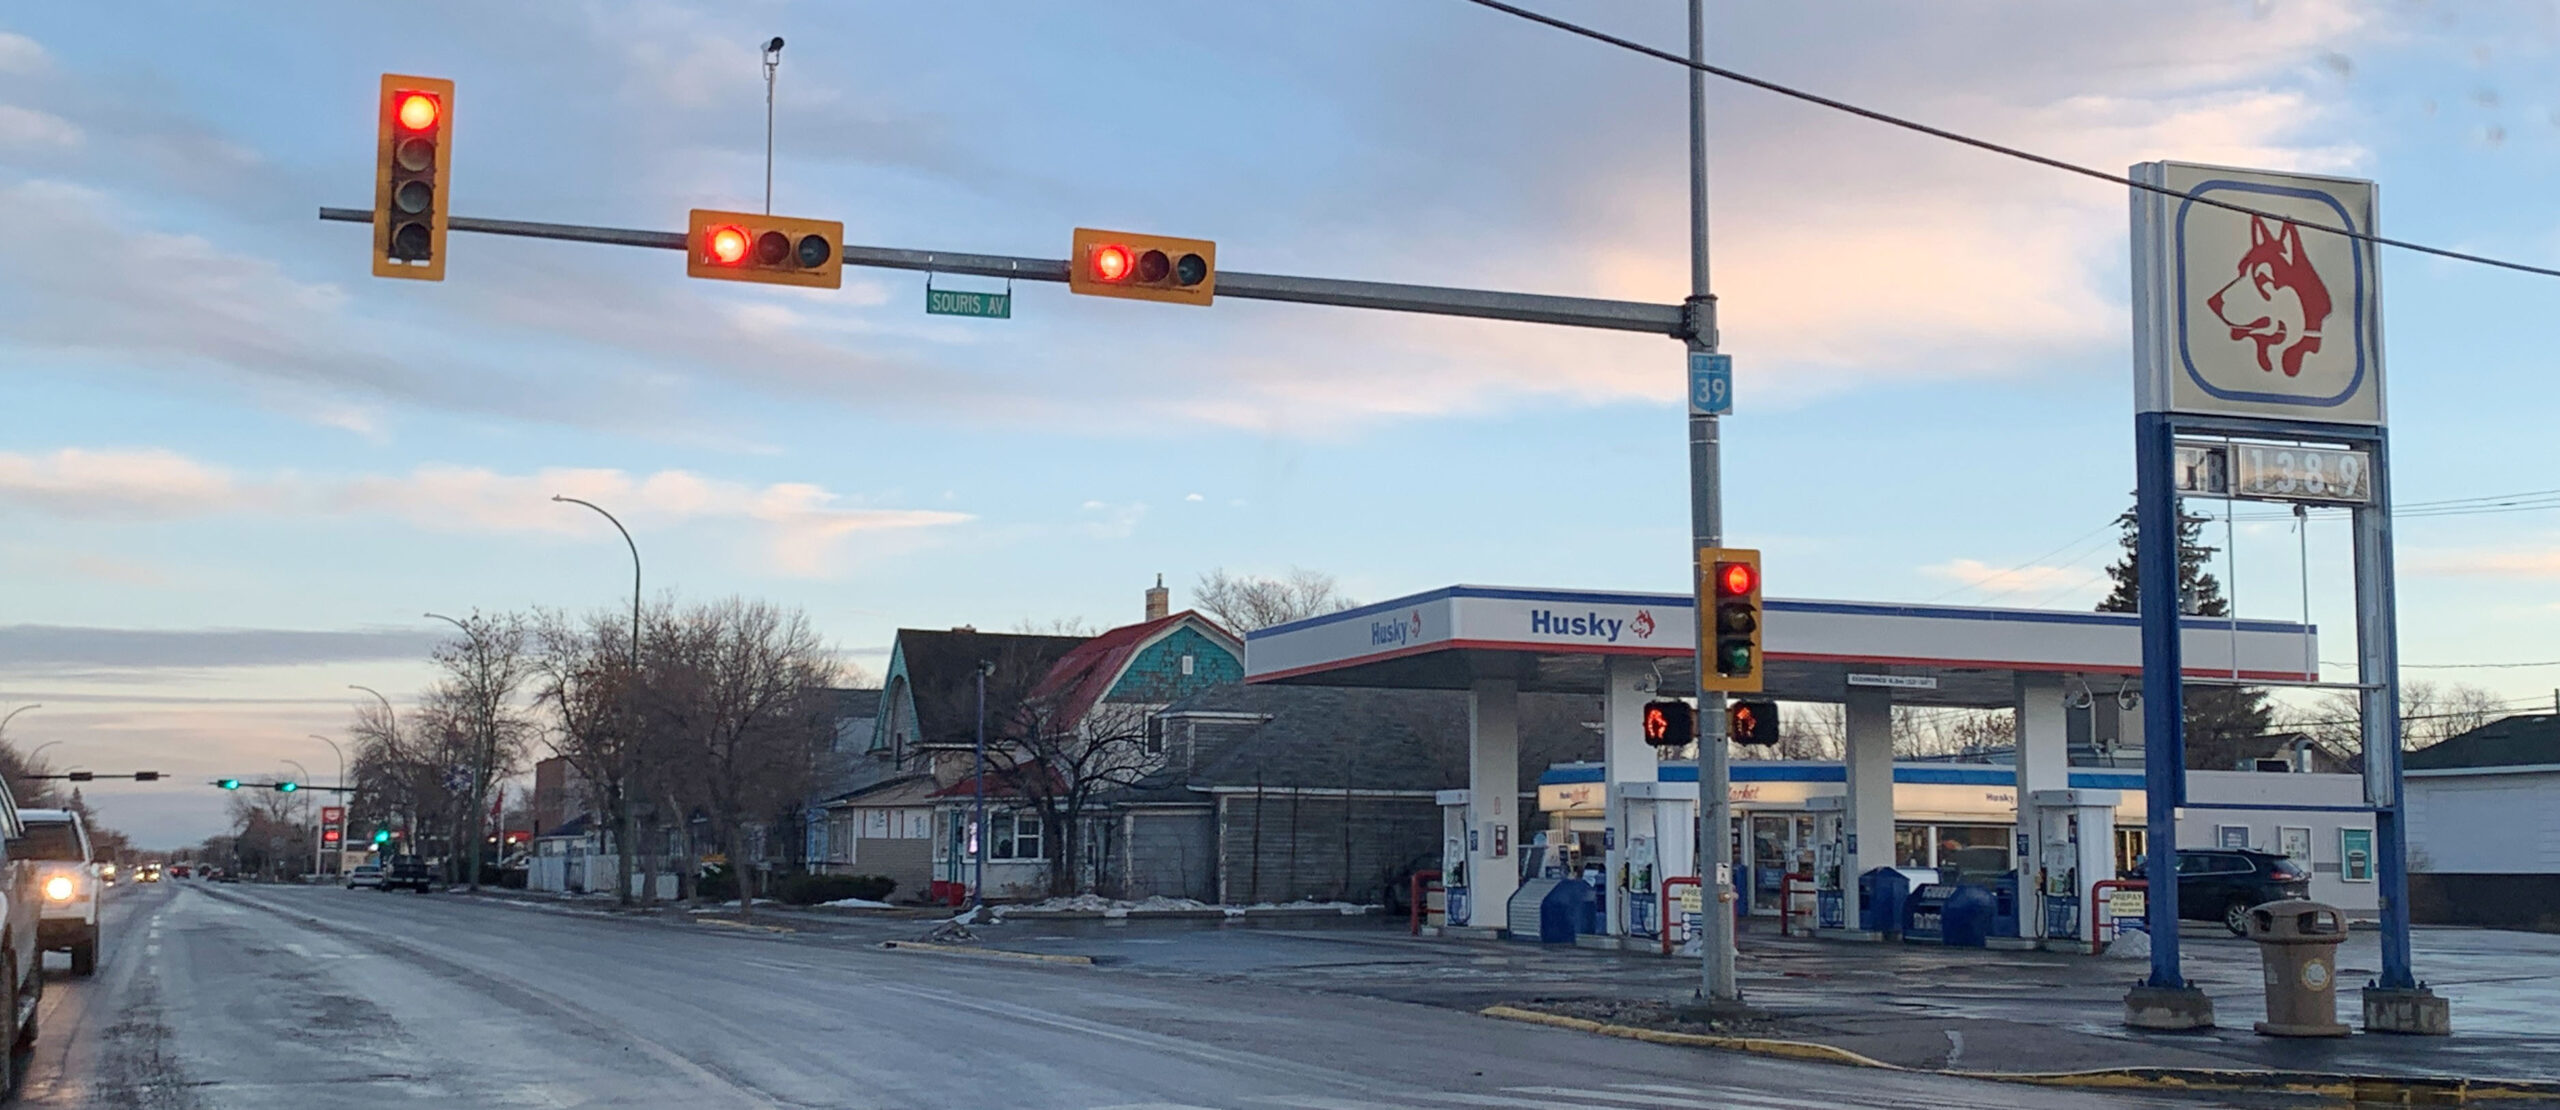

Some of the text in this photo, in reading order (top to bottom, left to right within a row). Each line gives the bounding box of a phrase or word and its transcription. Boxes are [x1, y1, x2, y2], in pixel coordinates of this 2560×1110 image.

[932, 293, 1005, 314] SOURIS AV
[1697, 378, 1725, 403] 39
[1371, 617, 1407, 646] Husky
[1531, 609, 1623, 642] Husky
[1986, 793, 2014, 805] Husky
